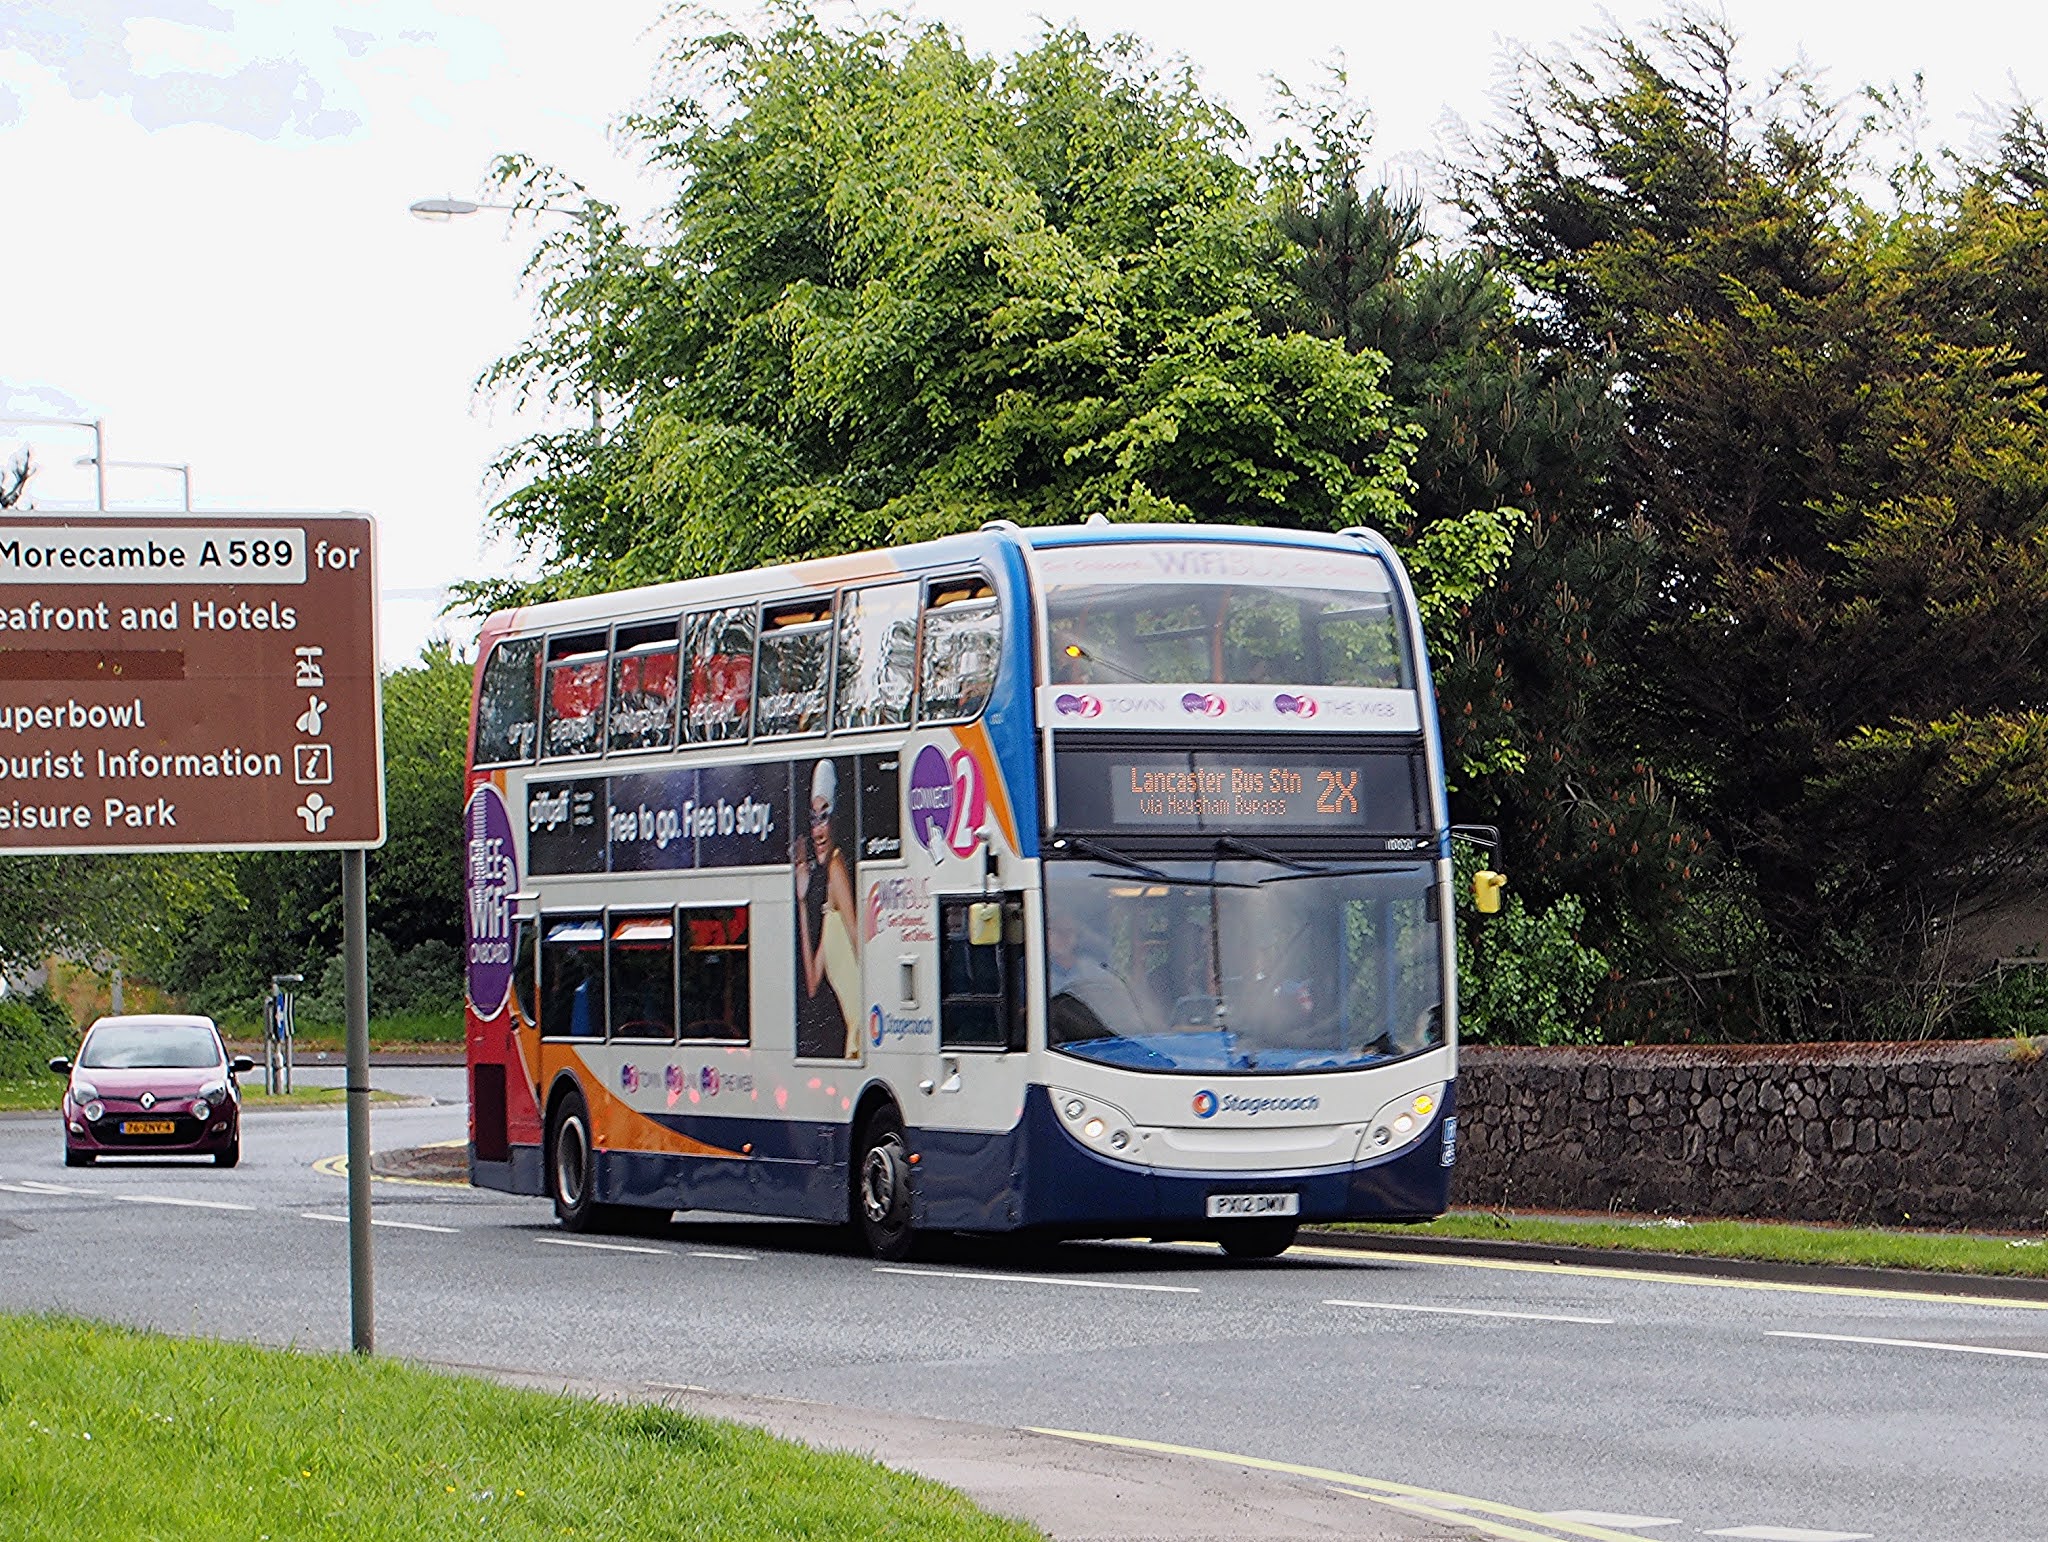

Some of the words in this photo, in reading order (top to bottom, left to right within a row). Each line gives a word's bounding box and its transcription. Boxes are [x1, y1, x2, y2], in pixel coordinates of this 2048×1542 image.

[0, 540, 186, 568] Morecambe
[315, 541, 360, 569] for
[120, 601, 179, 630] and
[192, 601, 297, 630] Hotels
[0, 699, 146, 733] uperbowl
[97, 748, 282, 778] Information
[953, 755, 975, 849] 2
[1131, 767, 1226, 793] Lancaster
[1231, 768, 1264, 793] Bus
[1269, 768, 1302, 793] Stn
[1316, 771, 1359, 814] 2X
[1139, 795, 1163, 815] via
[1168, 795, 1230, 815] Heysham
[1234, 795, 1287, 815] Bypass
[0, 800, 91, 830] eisure
[104, 798, 177, 828] Park
[683, 800, 716, 838] Free
[1221, 1094, 1320, 1117] Stagecoach
